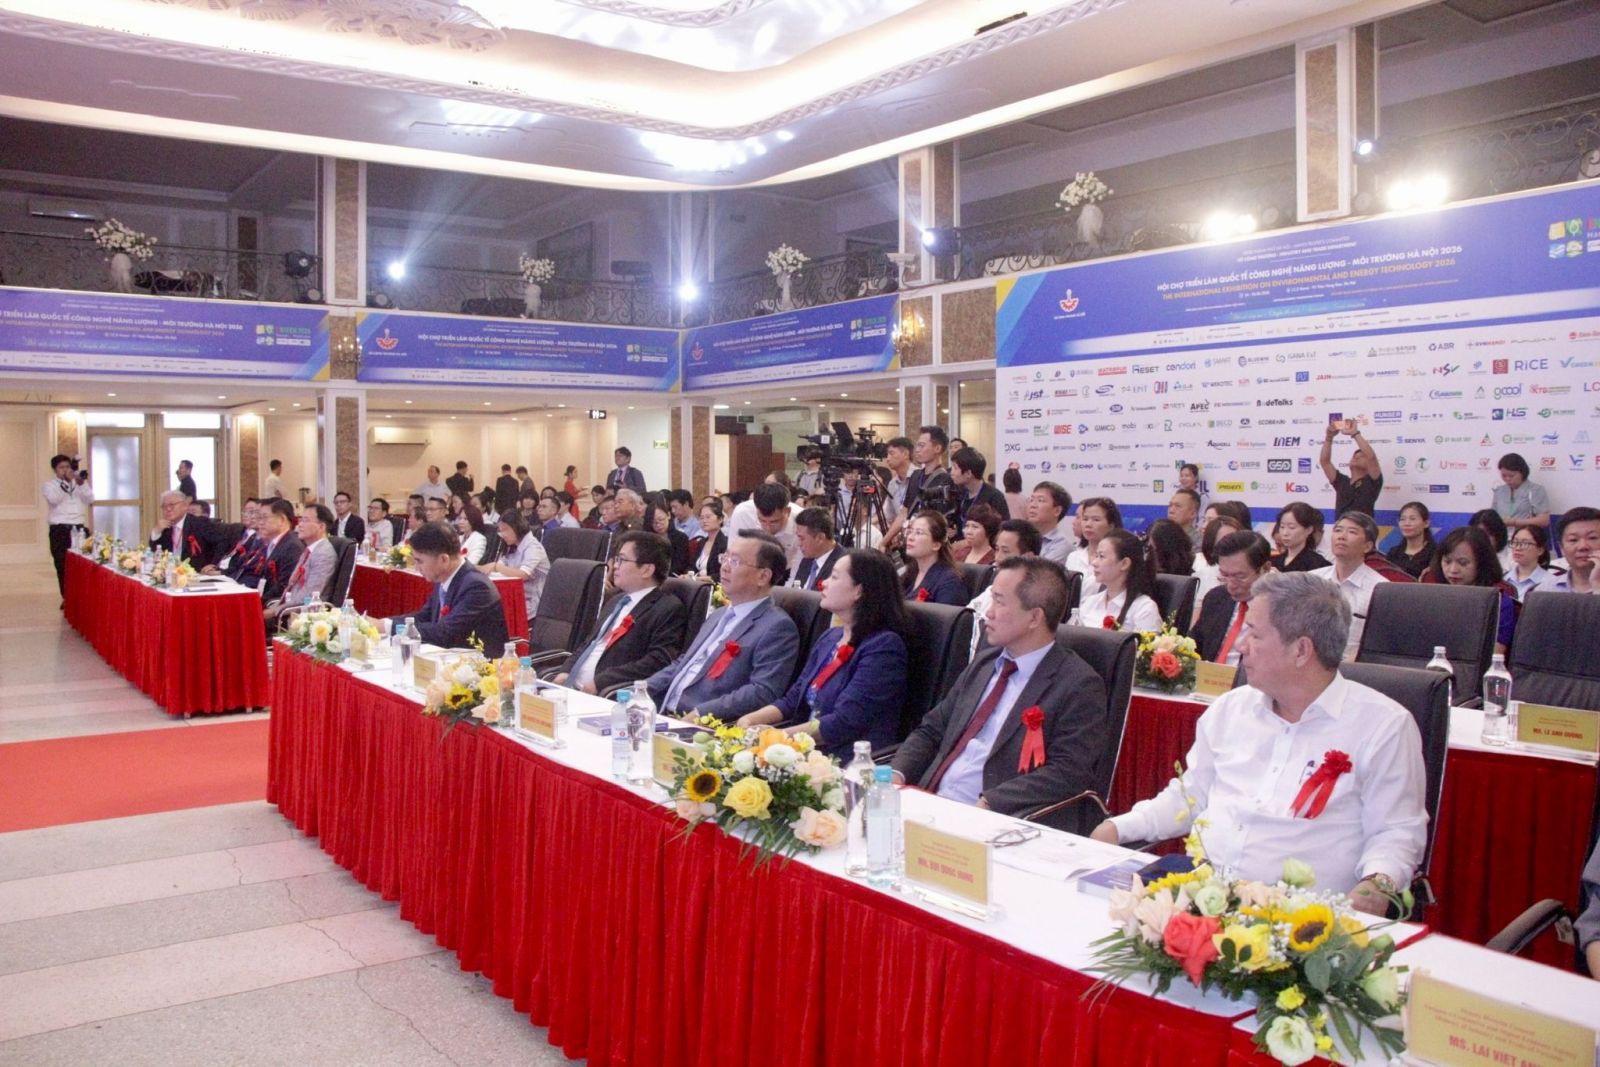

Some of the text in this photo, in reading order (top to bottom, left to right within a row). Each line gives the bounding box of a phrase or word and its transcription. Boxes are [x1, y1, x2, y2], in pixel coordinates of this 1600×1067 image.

[1249, 269, 1270, 279] CÔNG
[1352, 256, 1369, 266] MÔI
[1407, 249, 1420, 259] HÀ
[1421, 246, 1439, 257] NỘI
[1440, 245, 1462, 255] 2026
